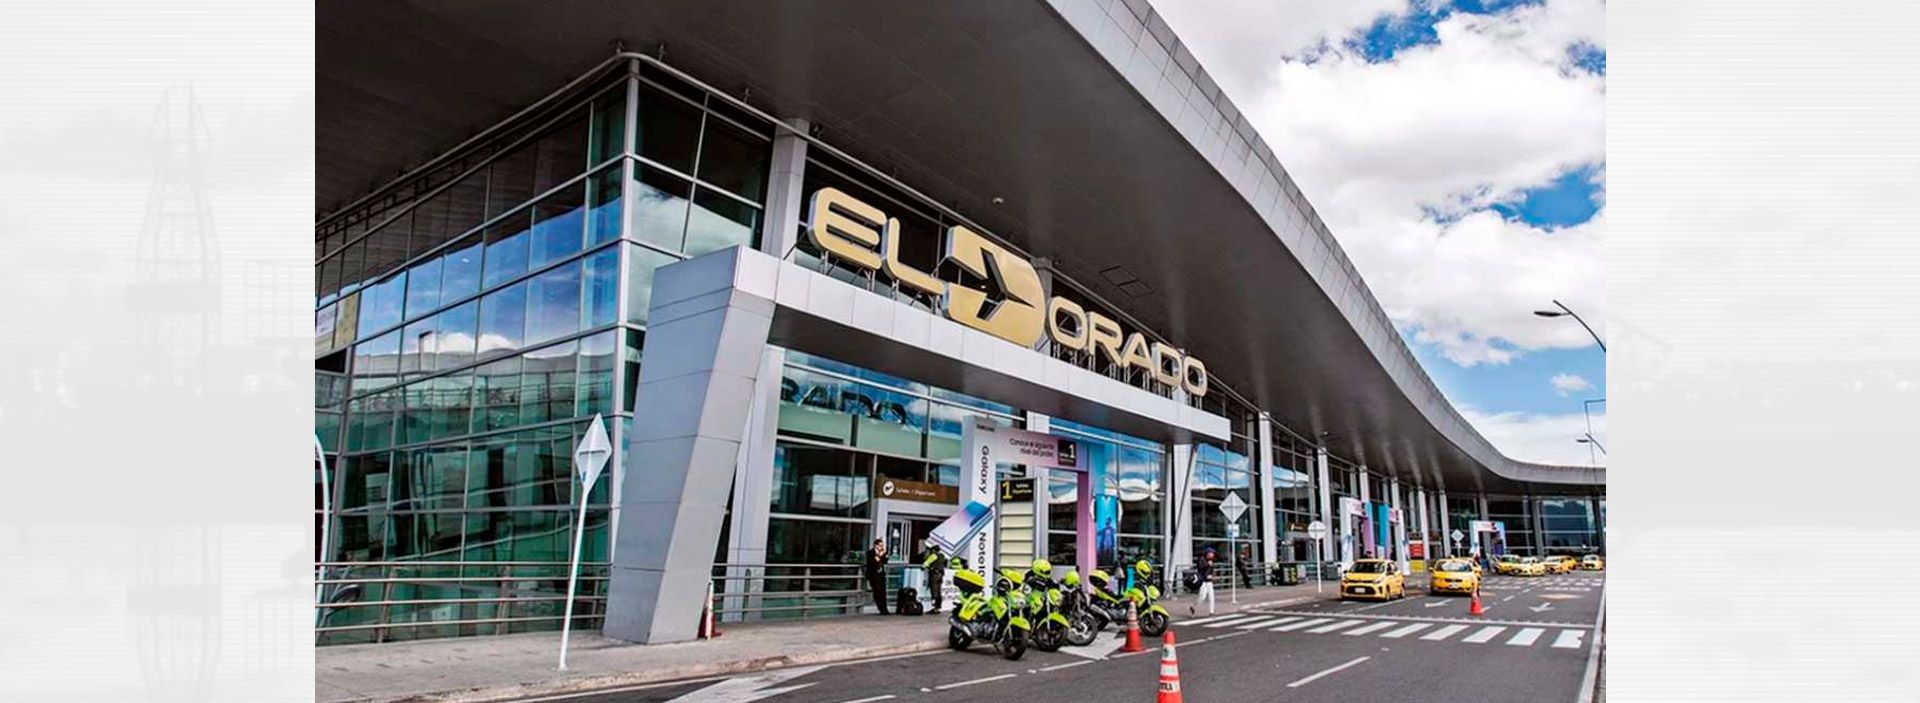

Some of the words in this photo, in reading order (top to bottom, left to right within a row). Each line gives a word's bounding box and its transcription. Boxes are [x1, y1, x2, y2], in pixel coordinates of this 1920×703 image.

[809, 187, 944, 295] EL
[943, 225, 1208, 397] DORADO
[1069, 443, 1076, 459] 1
[978, 445, 990, 494] Galaxy
[1002, 480, 1013, 500] 1
